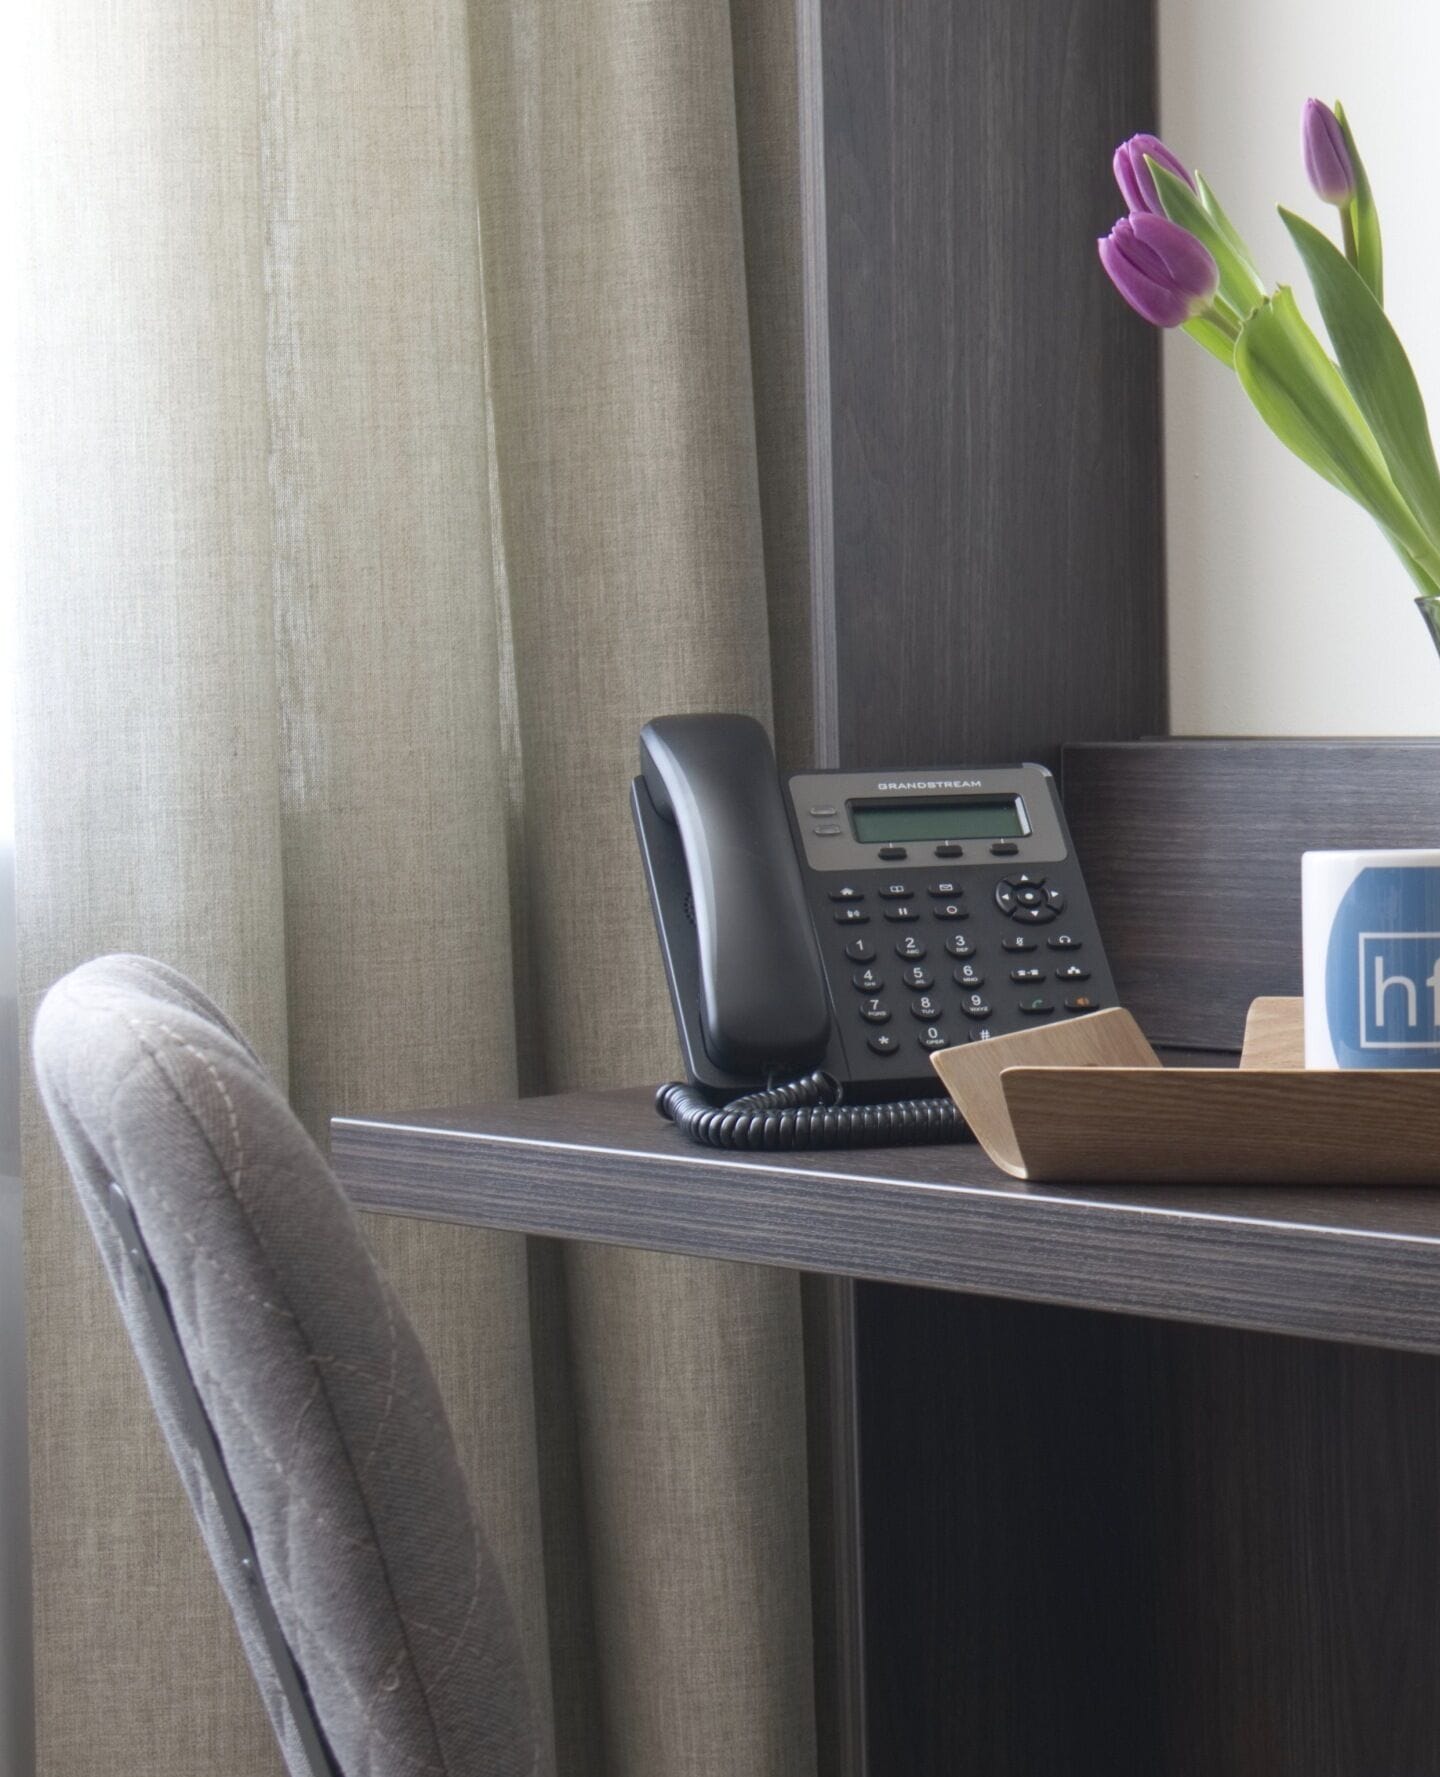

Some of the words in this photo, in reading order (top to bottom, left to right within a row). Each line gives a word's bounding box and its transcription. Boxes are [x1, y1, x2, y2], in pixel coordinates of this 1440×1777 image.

[878, 780, 982, 790] GRANDSTREAM
[856, 939, 864, 951] 1
[905, 937, 915, 948] 2
[955, 935, 965, 946] 3
[864, 970, 873, 980] 4
[913, 967, 923, 978] 5
[963, 965, 973, 976] 6
[869, 999, 879, 1010] 7
[921, 997, 931, 1008] 8
[971, 995, 981, 1006] 9
[928, 1028, 938, 1038] 0
